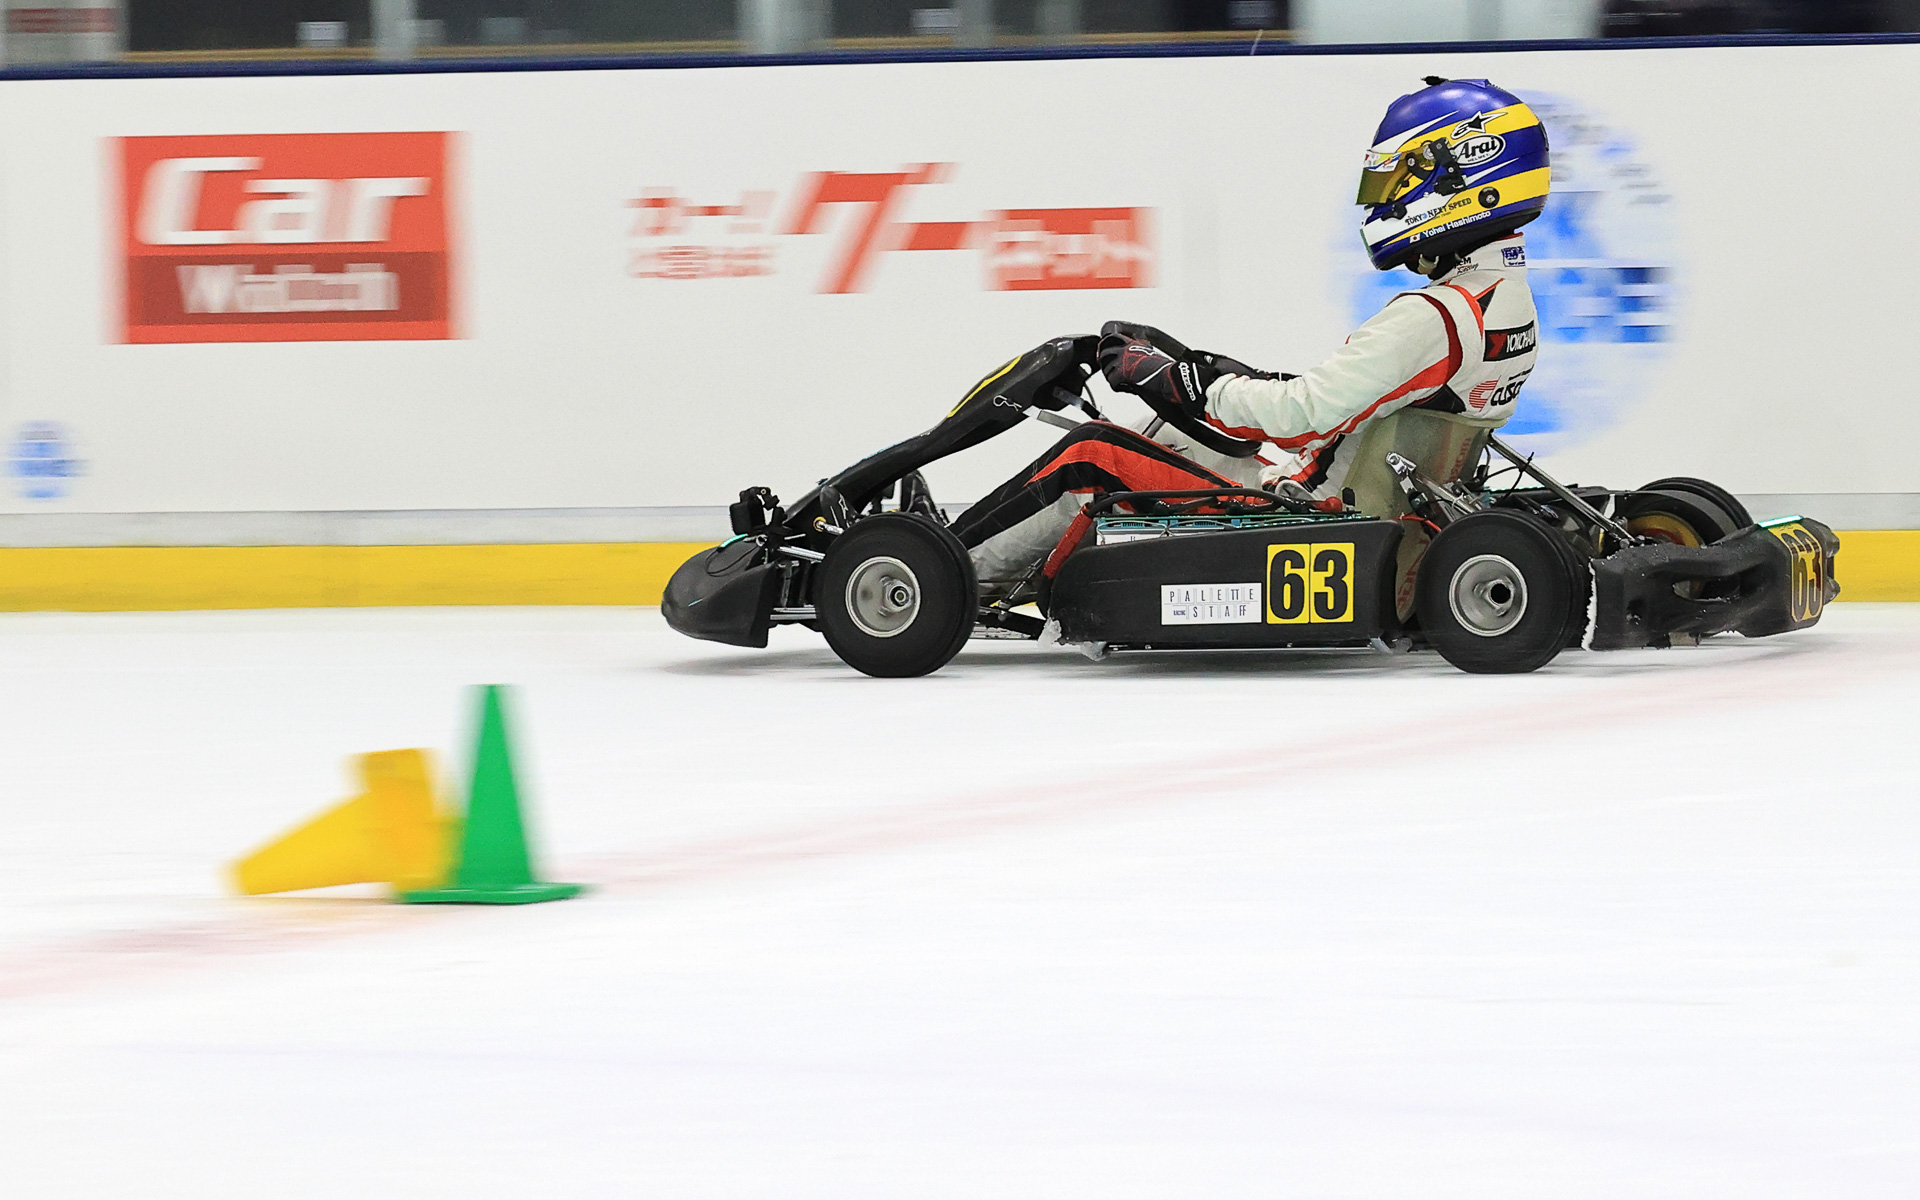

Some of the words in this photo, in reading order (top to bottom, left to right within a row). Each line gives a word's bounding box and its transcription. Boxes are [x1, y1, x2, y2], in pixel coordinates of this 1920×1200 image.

[1456, 135, 1498, 160] Arai
[134, 156, 432, 245] Car
[1427, 204, 1447, 218] NEXT
[1448, 197, 1472, 211] SPEED
[1422, 226, 1446, 238] Yohei
[1445, 210, 1492, 231] Hashimoto
[1270, 548, 1349, 620] 63
[1780, 529, 1822, 620] 63
[1169, 588, 1254, 602] PALETTE
[1192, 605, 1247, 618] STAFF
